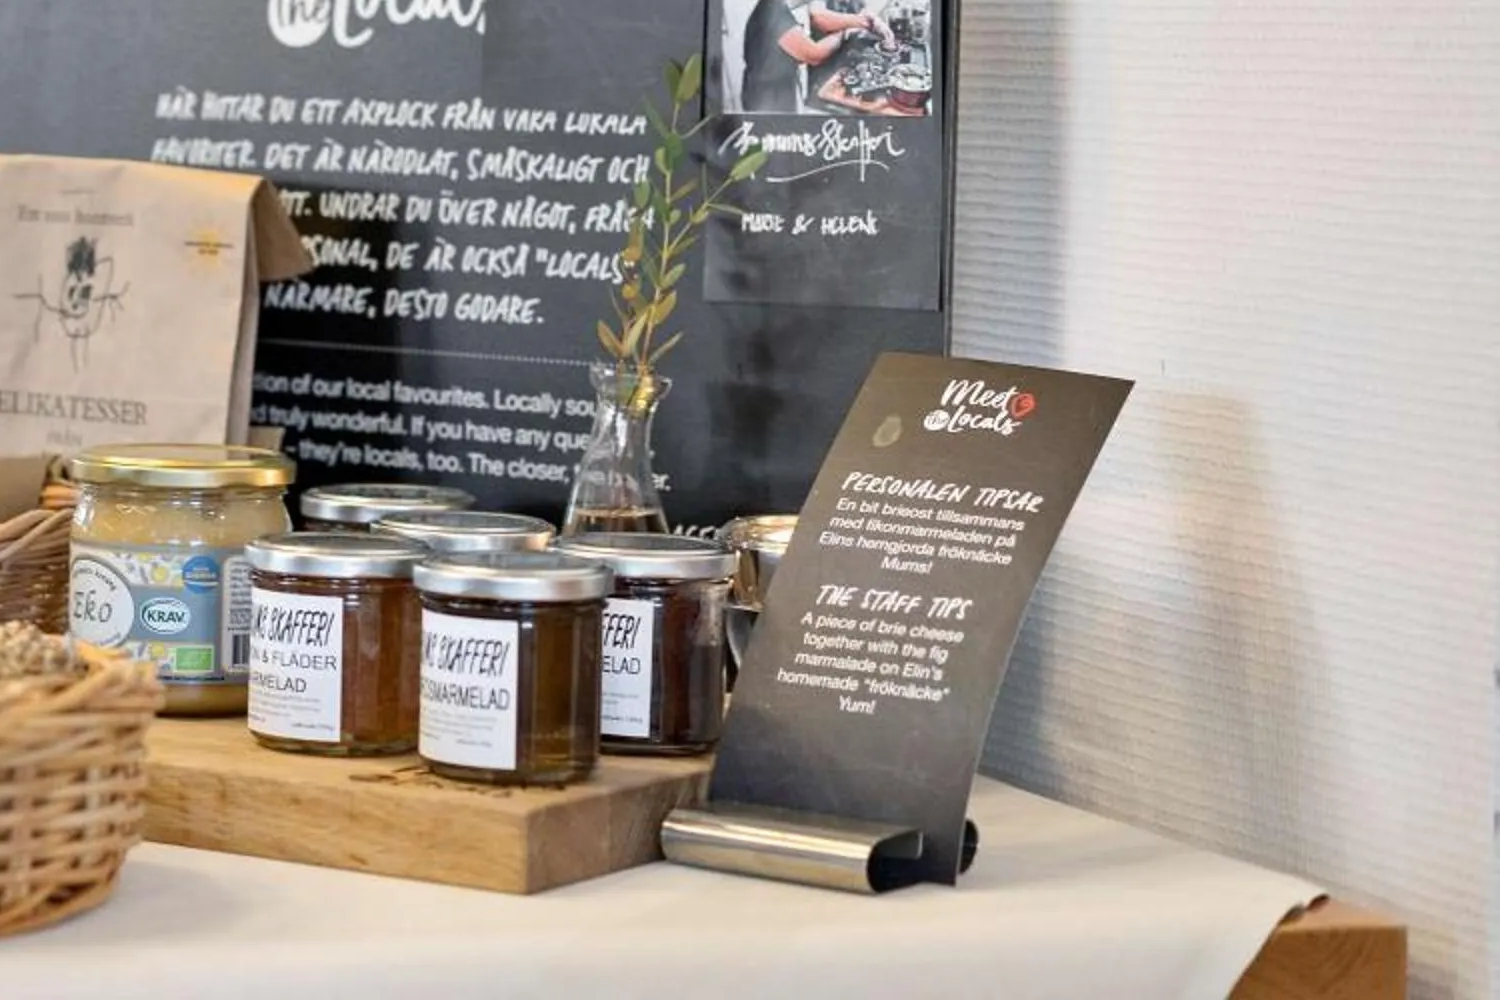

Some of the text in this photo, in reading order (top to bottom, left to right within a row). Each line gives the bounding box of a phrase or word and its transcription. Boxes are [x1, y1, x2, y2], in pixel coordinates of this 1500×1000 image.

[155, 85, 198, 120] HÄR
[268, 96, 297, 124] DU
[301, 98, 344, 125] ETT
[342, 97, 439, 128] AXPLOCK
[441, 97, 496, 132] FRÅN
[263, 141, 311, 171] DET
[314, 137, 347, 172] ÄR
[346, 138, 459, 182] NÄRODLAT,
[466, 145, 604, 183] SMÅSKALIGT
[606, 153, 651, 184] OCH
[319, 191, 401, 222] UNDRAR
[405, 195, 433, 223] DU
[438, 189, 498, 227] ÖVER
[501, 194, 576, 235] NÅGOT,
[301, 233, 379, 273] SONAL,
[385, 241, 419, 270] DE
[423, 236, 458, 272] ÄR
[461, 243, 531, 278] OCKSÅ
[383, 288, 449, 321] DESTO
[454, 292, 545, 325] GODARE.
[291, 373, 312, 396] of
[312, 378, 345, 398] our
[346, 377, 390, 402] local
[393, 380, 489, 409] favourites.
[493, 389, 561, 419] Locally
[940, 379, 1020, 407] Meet
[269, 405, 309, 432] truly
[311, 410, 407, 436] wonderful.
[411, 415, 426, 436] If
[426, 422, 462, 443] you
[465, 419, 512, 445] have
[514, 429, 550, 452] any
[947, 405, 1022, 436] Locals
[364, 444, 424, 471] locals,
[426, 451, 463, 473] too.
[467, 452, 505, 477] The
[507, 457, 571, 484] closer,
[842, 471, 1044, 513] PERSONALEN TIPSAR
[836, 498, 856, 512] En
[859, 500, 878, 514] bit
[936, 510, 1025, 531] tillsammans
[819, 531, 854, 547] Elins
[856, 534, 935, 556] hemgjorda
[829, 515, 864, 530] med
[994, 532, 1017, 548] på
[881, 557, 934, 575] Mums!
[148, 611, 186, 623] KRAV
[816, 584, 975, 620] THE STAFF TIPS
[801, 611, 965, 643] A piece of brie cheese
[602, 655, 641, 675] ELAD
[794, 652, 877, 673] marmalade
[879, 663, 899, 675] on
[803, 632, 949, 665] together with the fig
[777, 667, 859, 692] homemade
[838, 695, 877, 715] Yum!
